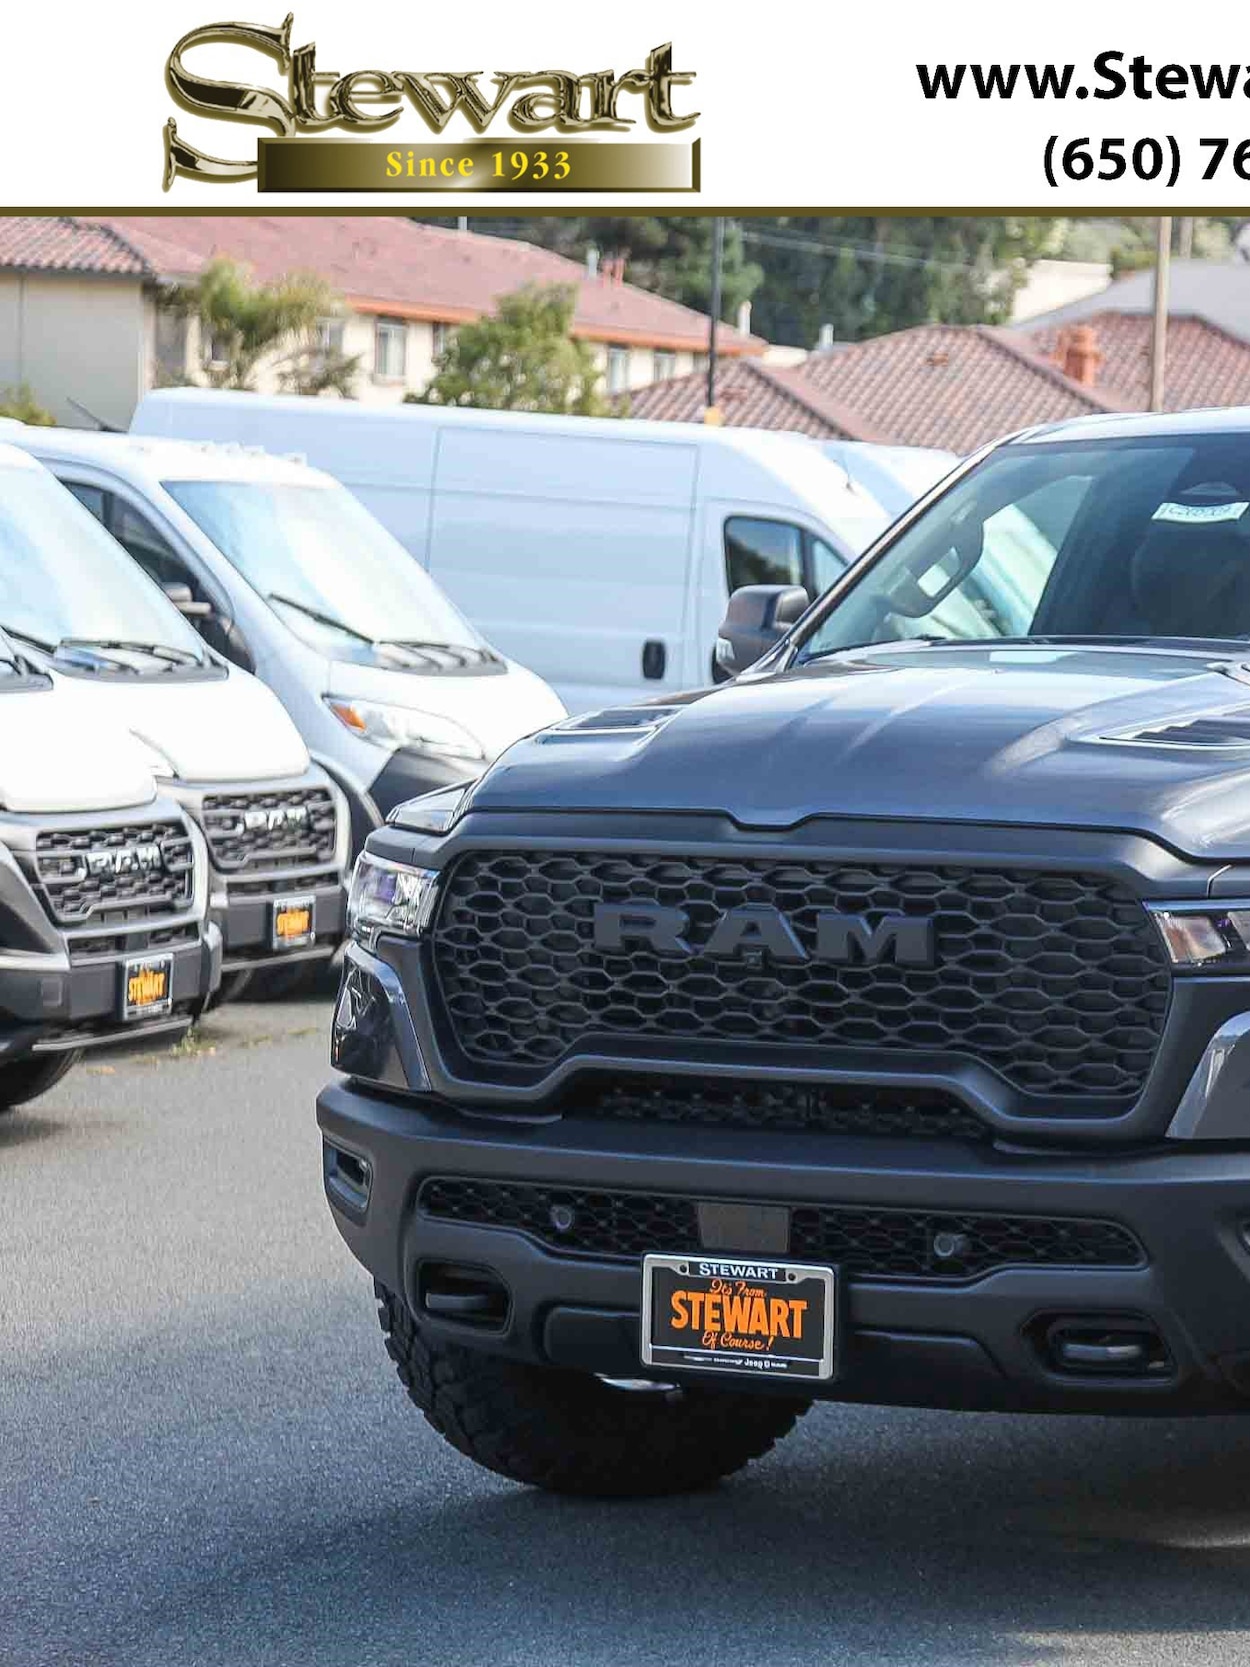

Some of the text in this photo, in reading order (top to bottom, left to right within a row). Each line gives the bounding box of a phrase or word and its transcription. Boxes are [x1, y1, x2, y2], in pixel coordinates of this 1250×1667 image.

[594, 902, 934, 965] RAM
[699, 1262, 778, 1280] STEWART
[709, 1279, 765, 1298] It's From
[670, 1290, 808, 1339] STEWART
[702, 1330, 718, 1350] Of
